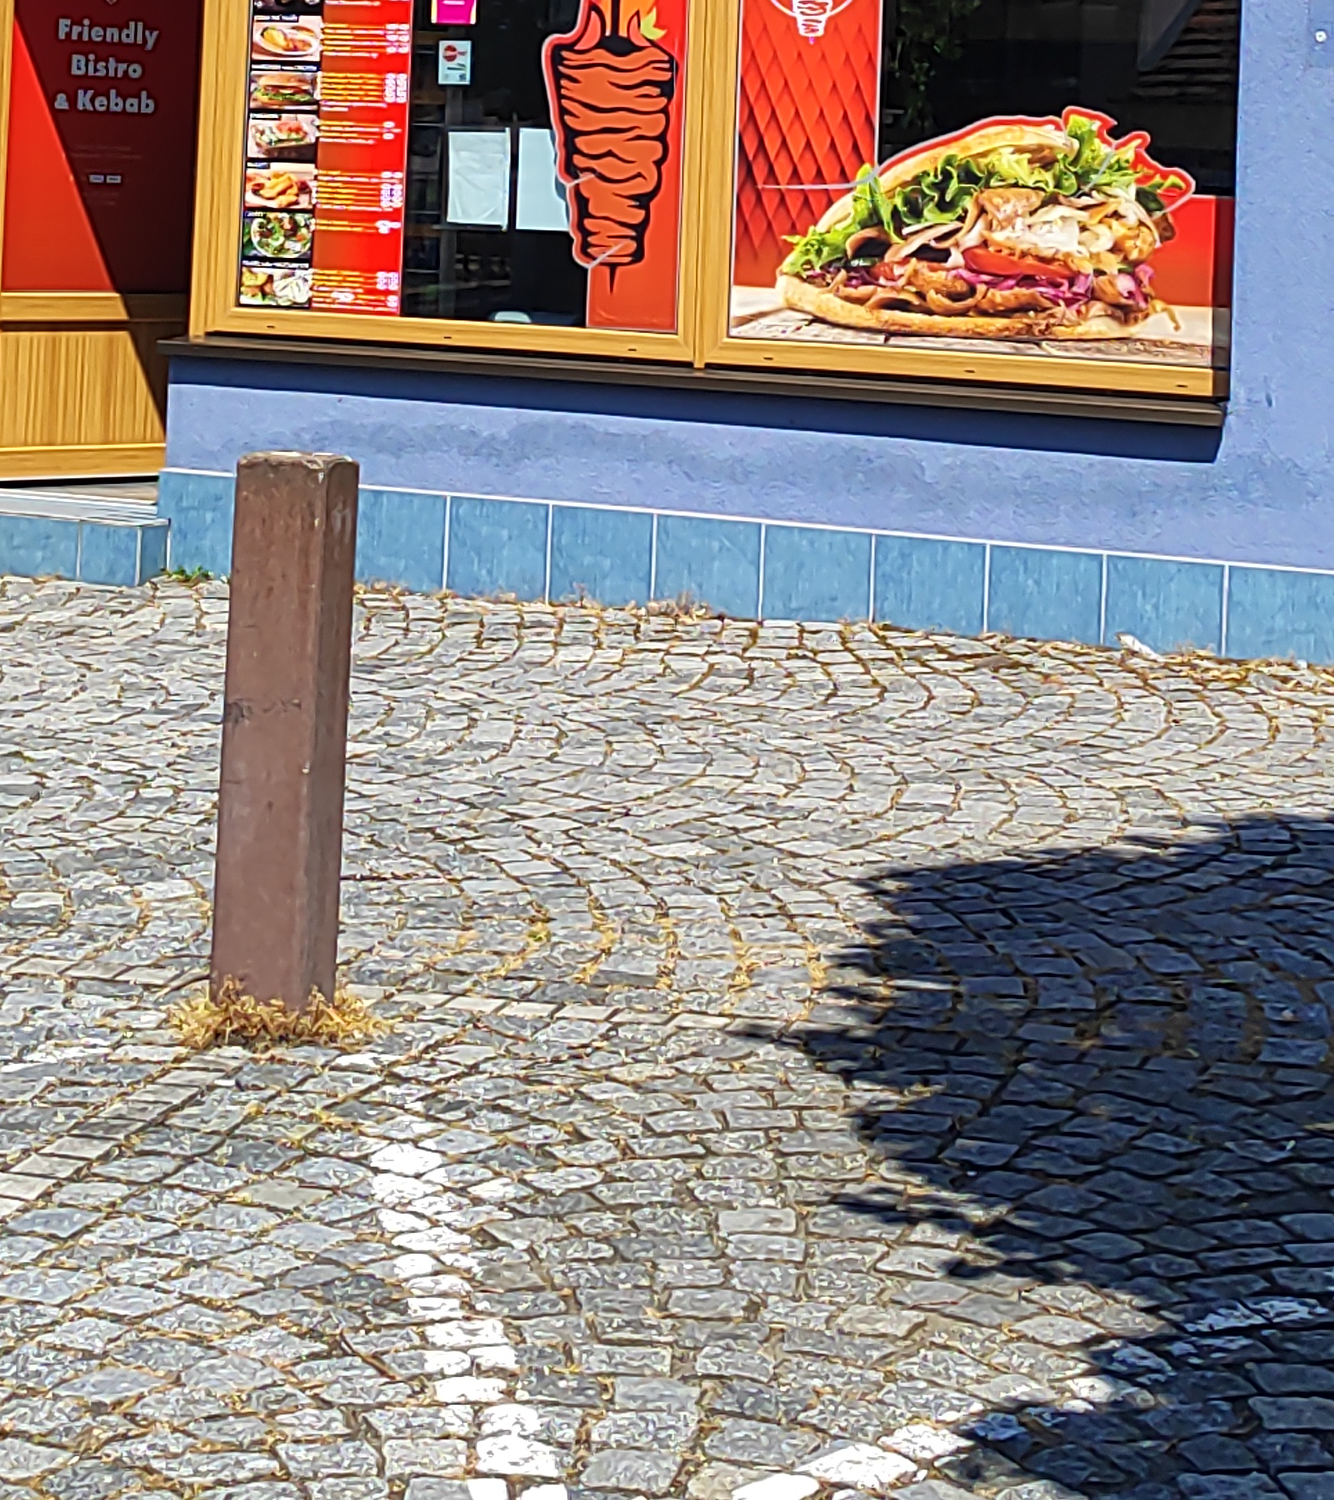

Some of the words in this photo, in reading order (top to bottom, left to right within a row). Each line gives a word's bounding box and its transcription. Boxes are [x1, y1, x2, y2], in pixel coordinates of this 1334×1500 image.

[57, 18, 160, 51] Friendly
[70, 55, 143, 80] Bistro
[54, 91, 70, 110] &
[76, 89, 156, 115] Kebab
